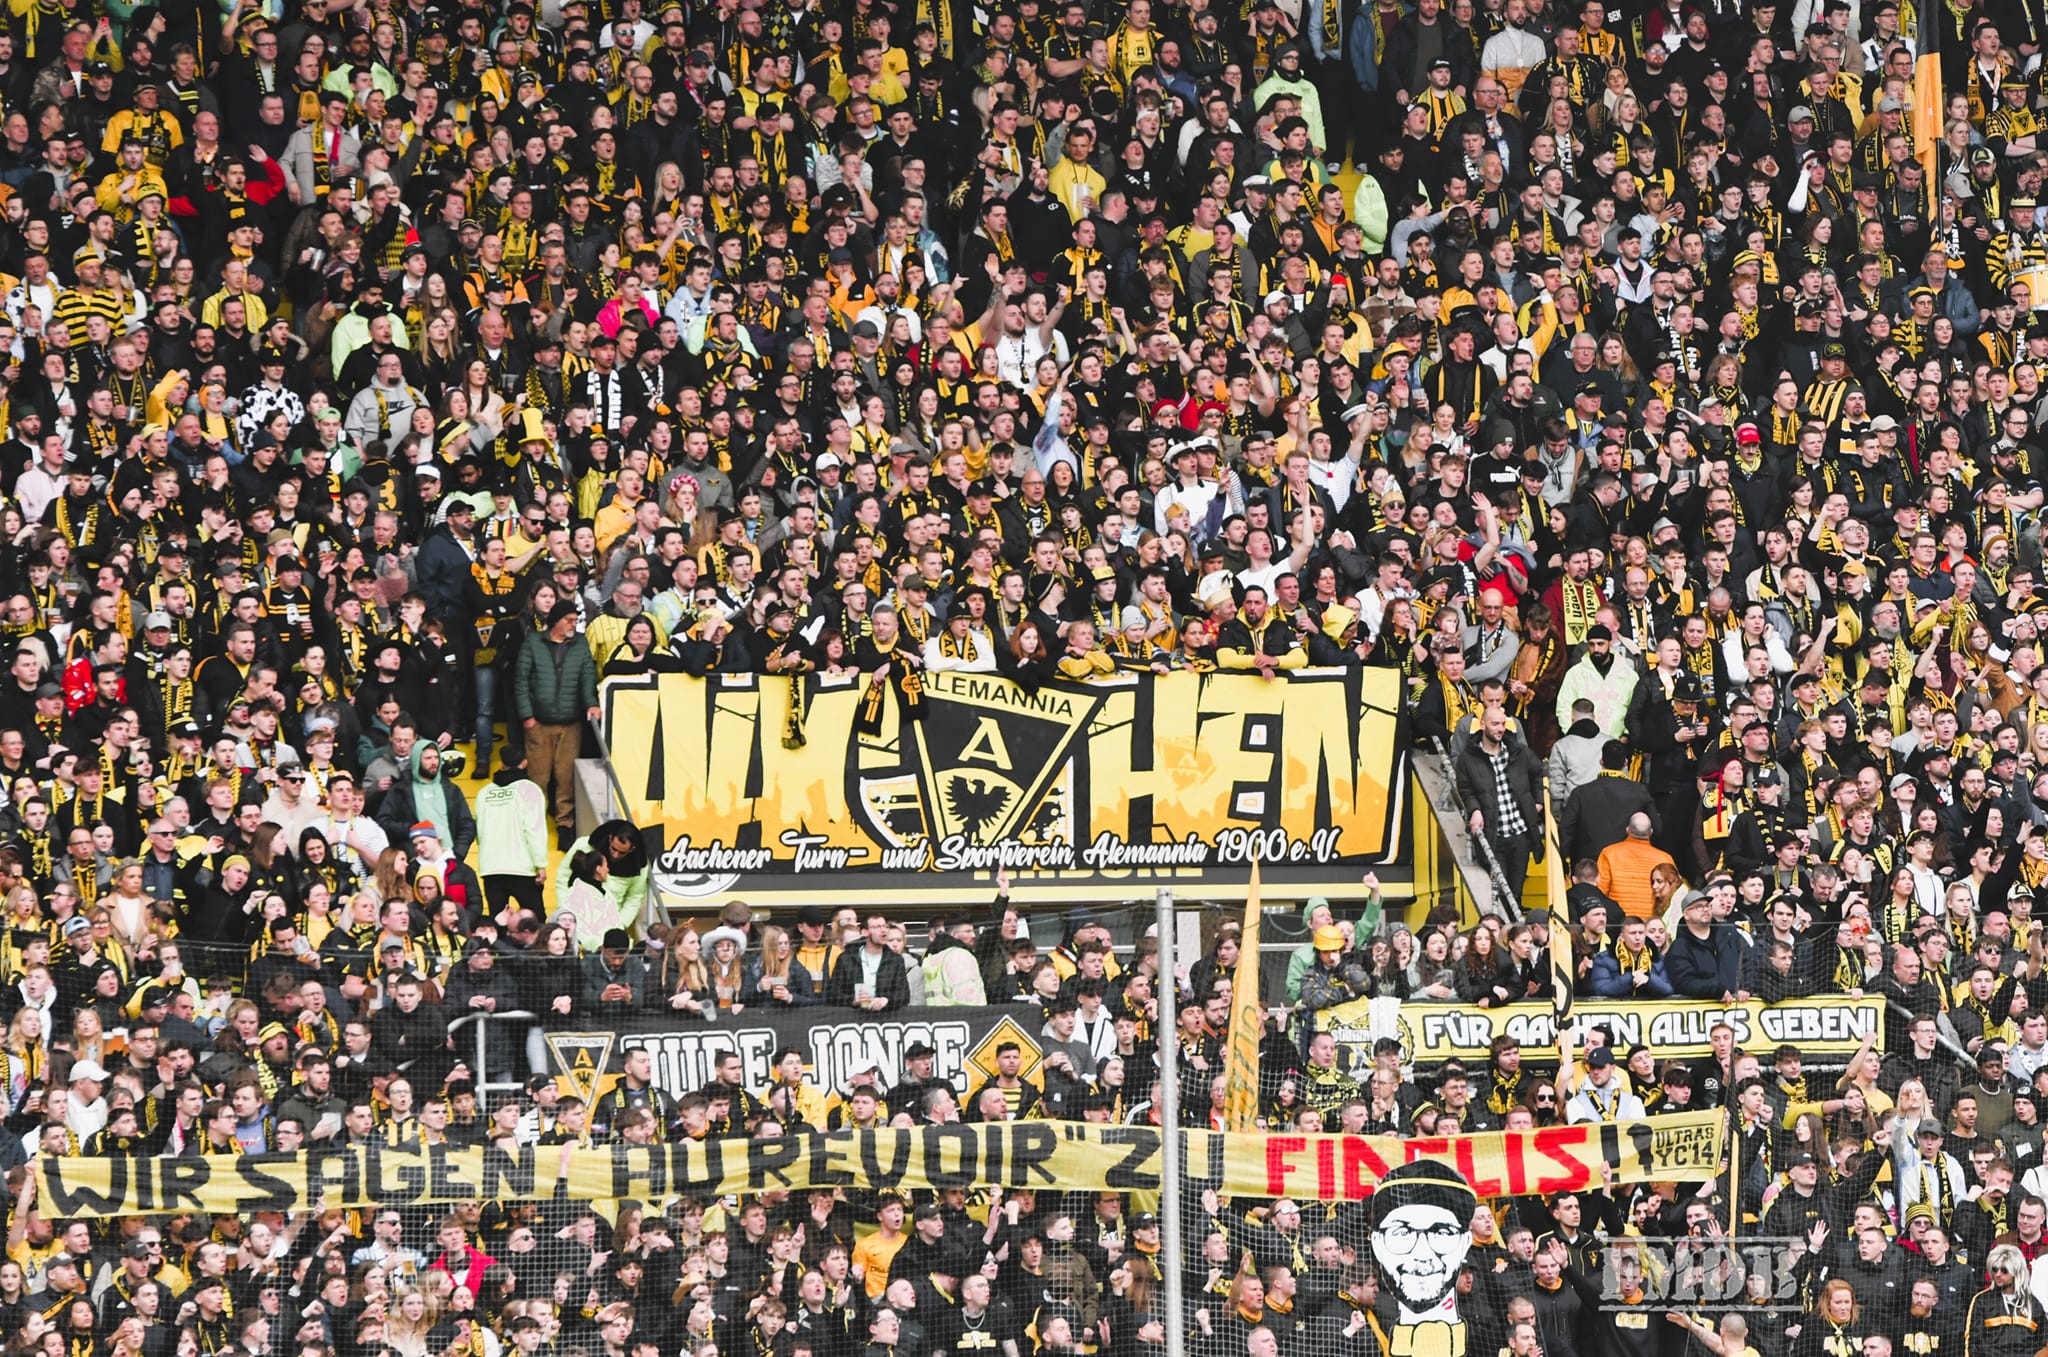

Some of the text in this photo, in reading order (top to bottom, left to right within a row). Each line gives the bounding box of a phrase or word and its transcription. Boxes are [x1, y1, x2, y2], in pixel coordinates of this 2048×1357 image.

[1489, 472, 1517, 483] PUMA
[378, 480, 398, 512] 3
[957, 717, 1014, 770] A
[661, 826, 1344, 873] Aachener Turn- und Sportverein Alemannia 1900 e.V.
[1423, 1010, 1493, 1048] FÜR
[1505, 1012, 1641, 1047] AAHN
[574, 1047, 594, 1067] A
[1655, 1127, 1715, 1150] ULTRAS
[1655, 1140, 1715, 1167] YC'14
[42, 1156, 211, 1217] WIR
[235, 1142, 536, 1212] SAGEN
[1100, 1127, 1226, 1195] ZU
